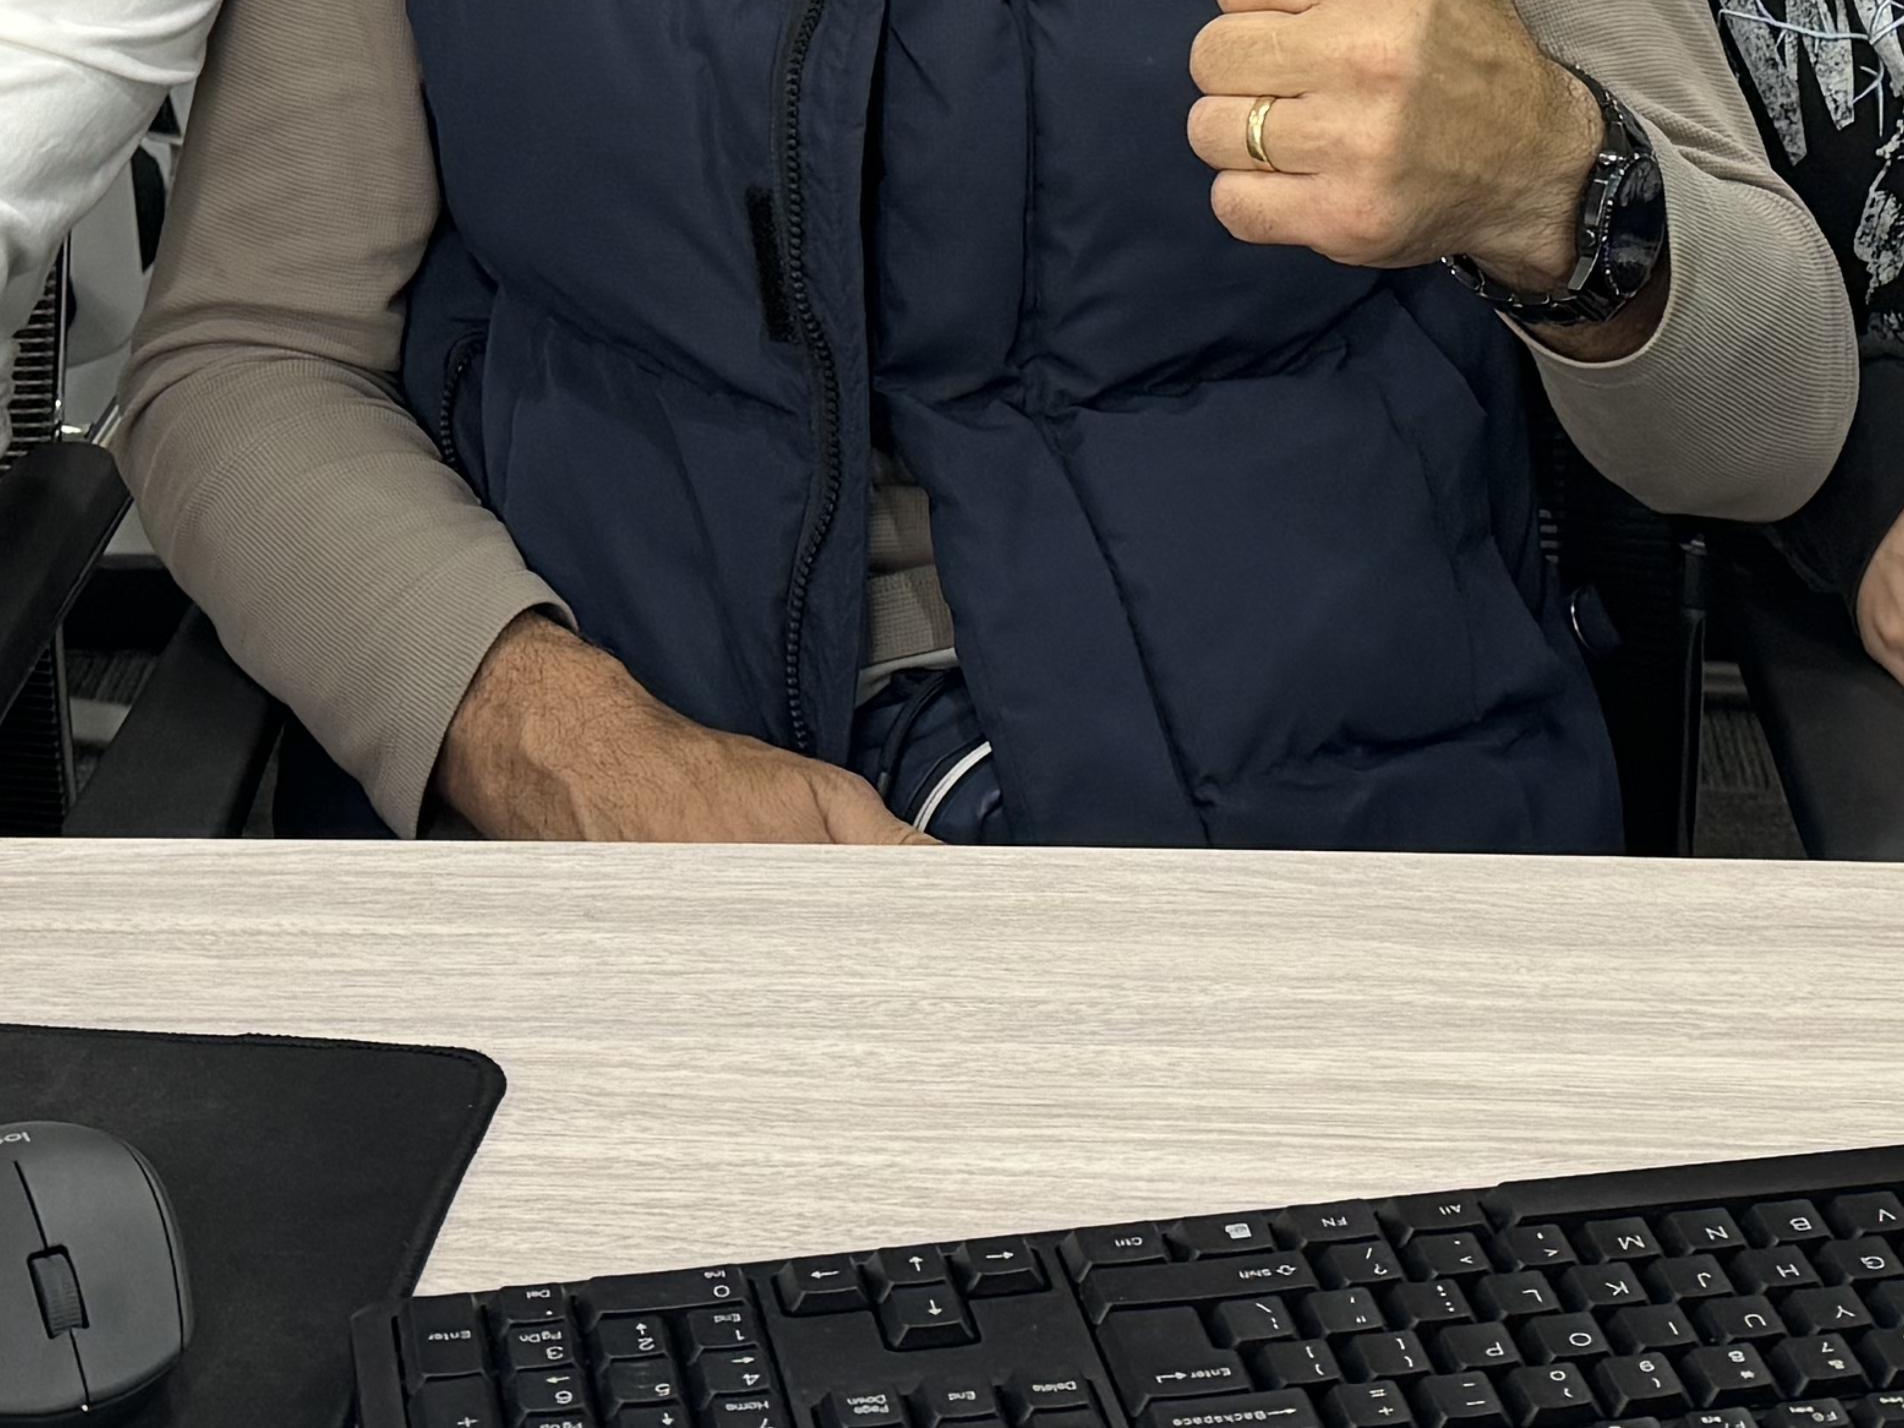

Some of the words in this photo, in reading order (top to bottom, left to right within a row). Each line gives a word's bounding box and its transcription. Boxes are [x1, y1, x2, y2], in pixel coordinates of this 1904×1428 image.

[1321, 1216, 1348, 1228] FN
[1879, 1208, 1897, 1223] V
[1789, 1216, 1813, 1232] B
[1704, 1225, 1729, 1240] N
[1617, 1234, 1645, 1250] M
[1860, 1255, 1886, 1270] G
[1776, 1263, 1800, 1278] H
[1697, 1271, 1712, 1288] J
[713, 1285, 730, 1298] 0
[1605, 1280, 1630, 1296] K
[1522, 1289, 1543, 1303] L
[1836, 1305, 1856, 1320] Y
[1744, 1313, 1767, 1328] U
[427, 1330, 472, 1341] Enter
[1569, 1332, 1592, 1347] O
[638, 1337, 656, 1351] 2
[1486, 1342, 1505, 1357] P
[545, 1346, 564, 1361] 3
[742, 1372, 760, 1387] 4
[1191, 1367, 1232, 1380] Enter
[654, 1382, 671, 1398] 5
[1032, 1380, 1077, 1393] Delete
[948, 1390, 976, 1402] End
